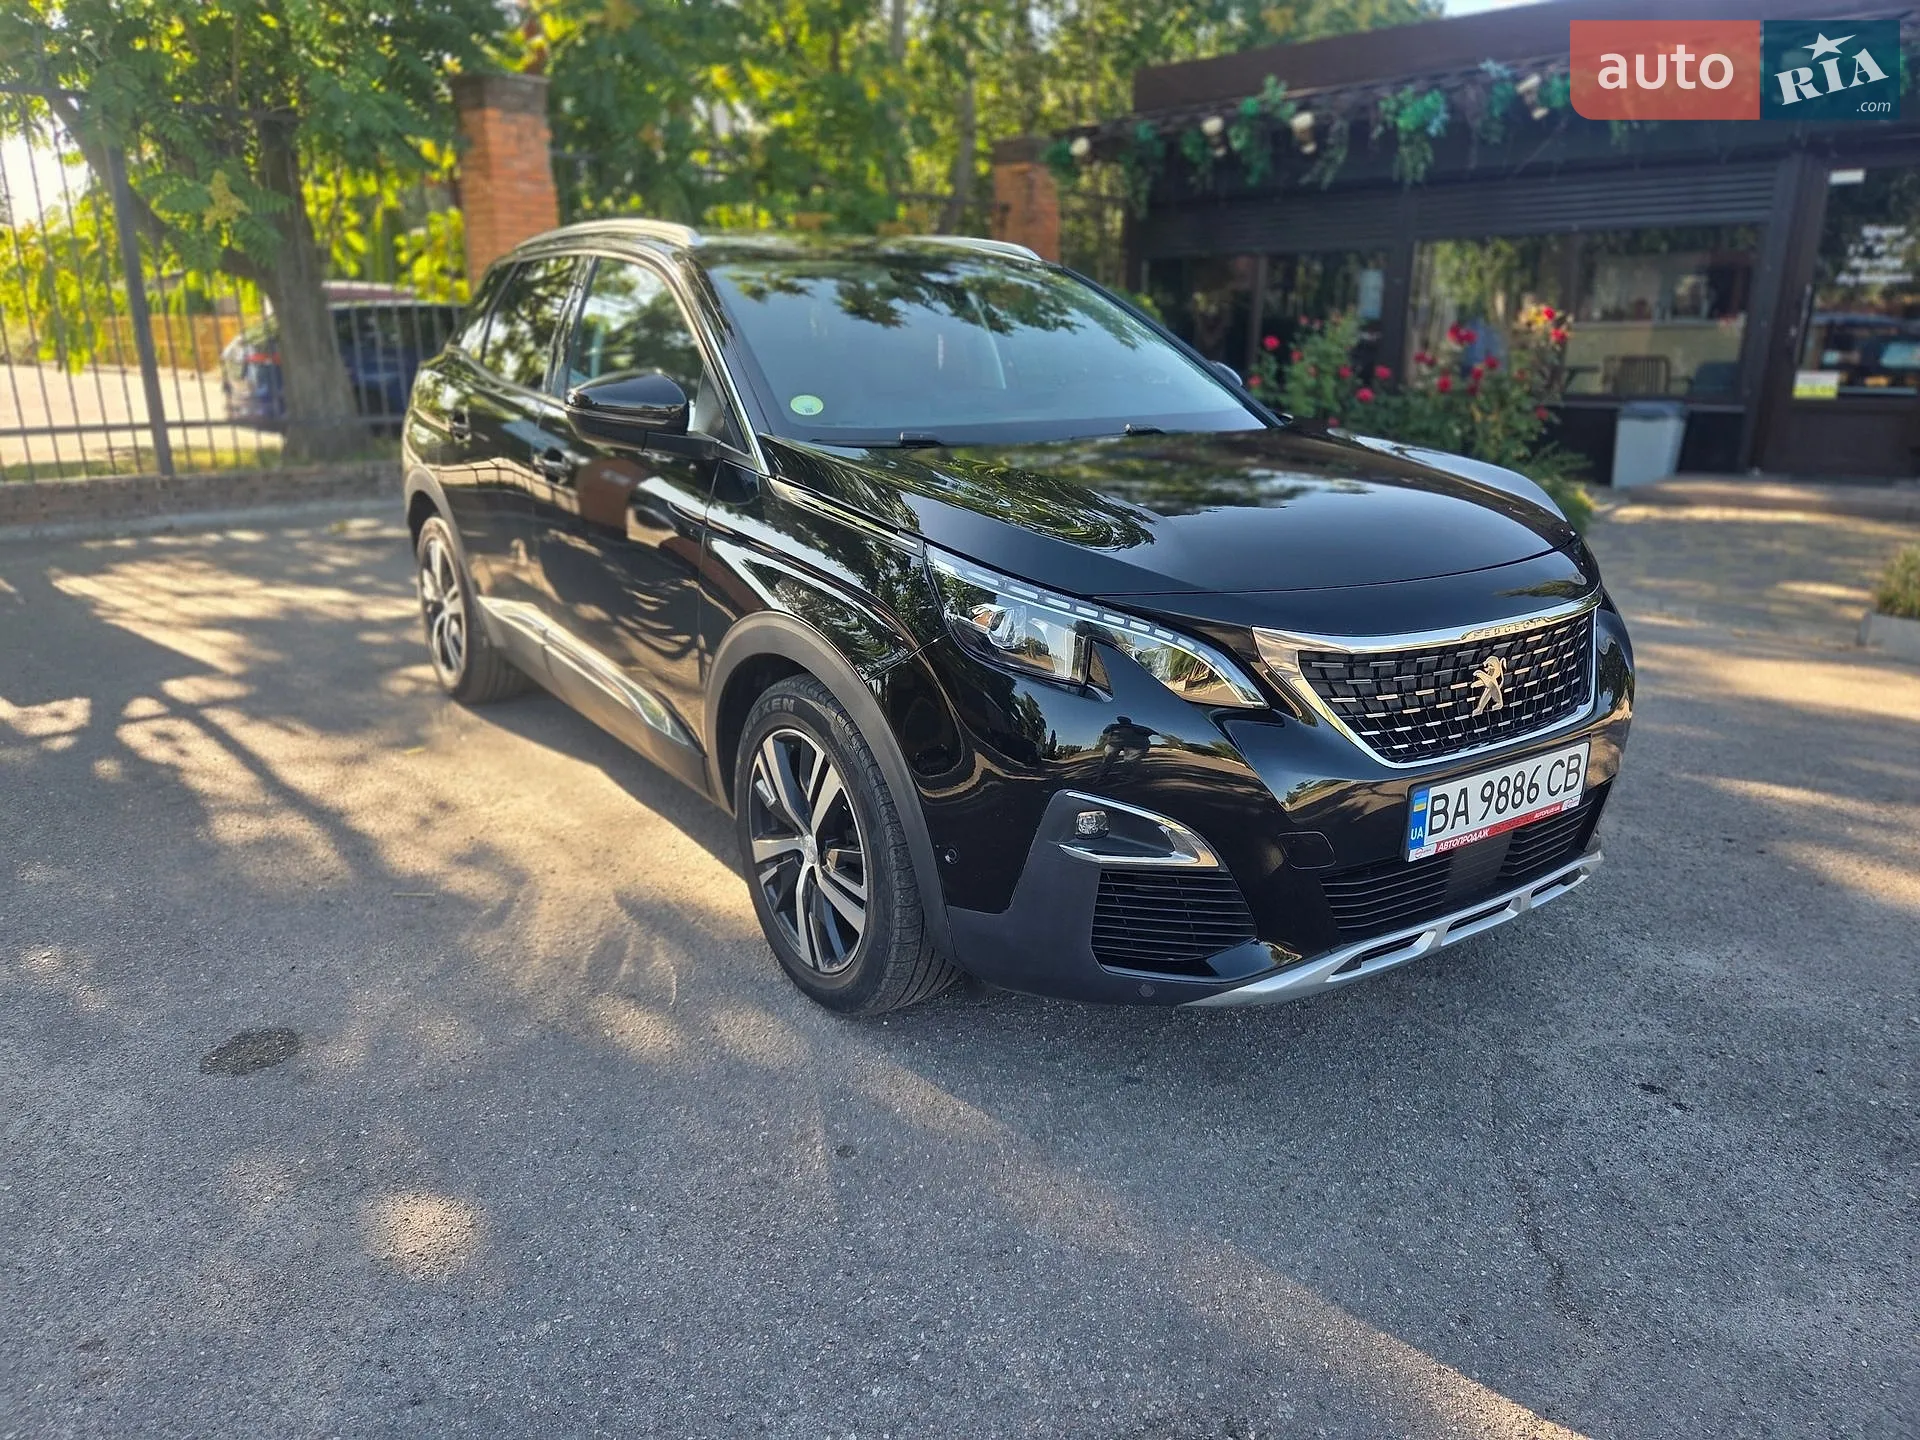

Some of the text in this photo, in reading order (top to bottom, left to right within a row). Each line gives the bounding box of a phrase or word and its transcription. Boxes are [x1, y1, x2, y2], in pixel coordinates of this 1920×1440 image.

[1428, 753, 1582, 836] BA 9886 CB
[1411, 826, 1424, 841] UA
[1438, 828, 1490, 851] АВТОПРОДАЖ
